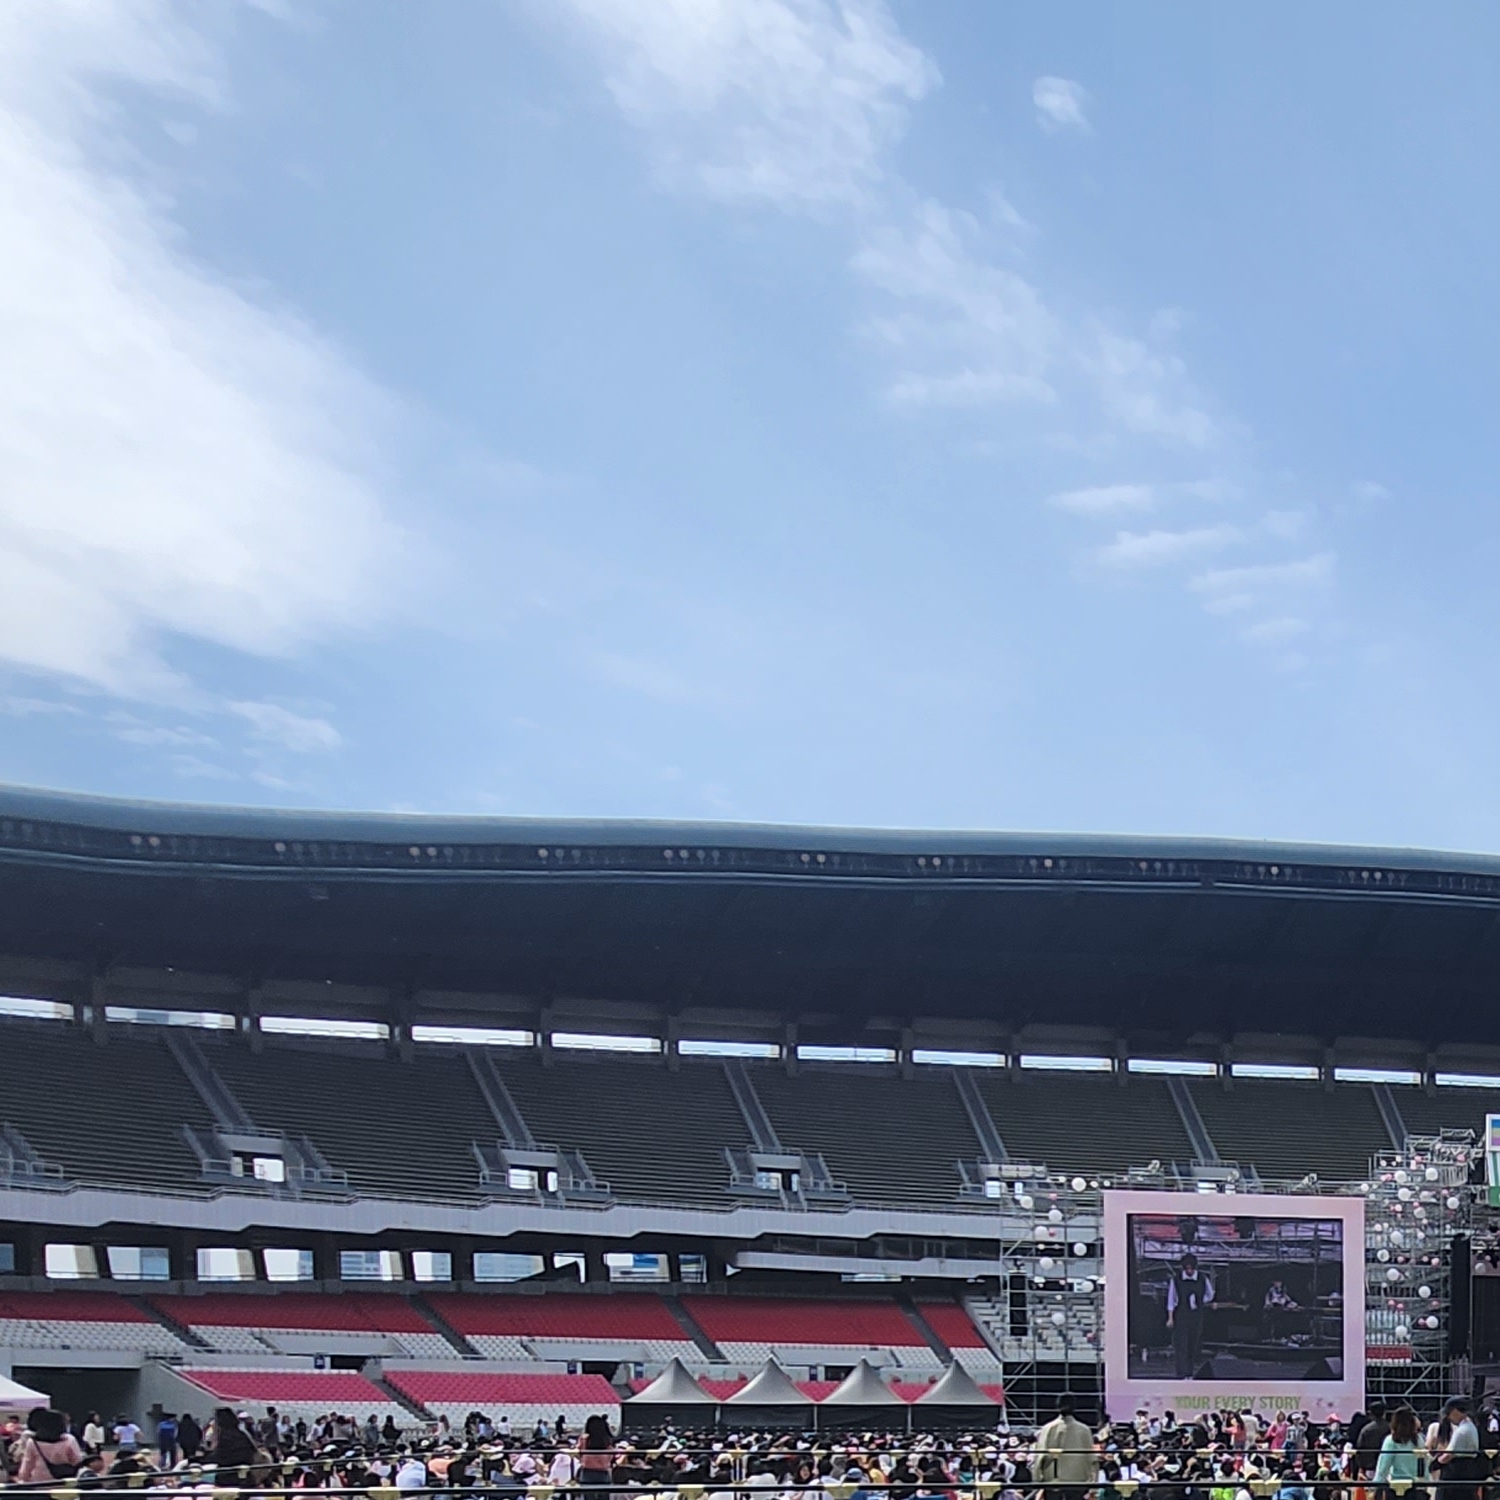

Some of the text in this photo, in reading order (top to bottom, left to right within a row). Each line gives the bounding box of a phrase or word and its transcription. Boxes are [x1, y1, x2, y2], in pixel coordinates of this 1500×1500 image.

[1174, 1395, 1301, 1410] YOUR EVERY STORY
